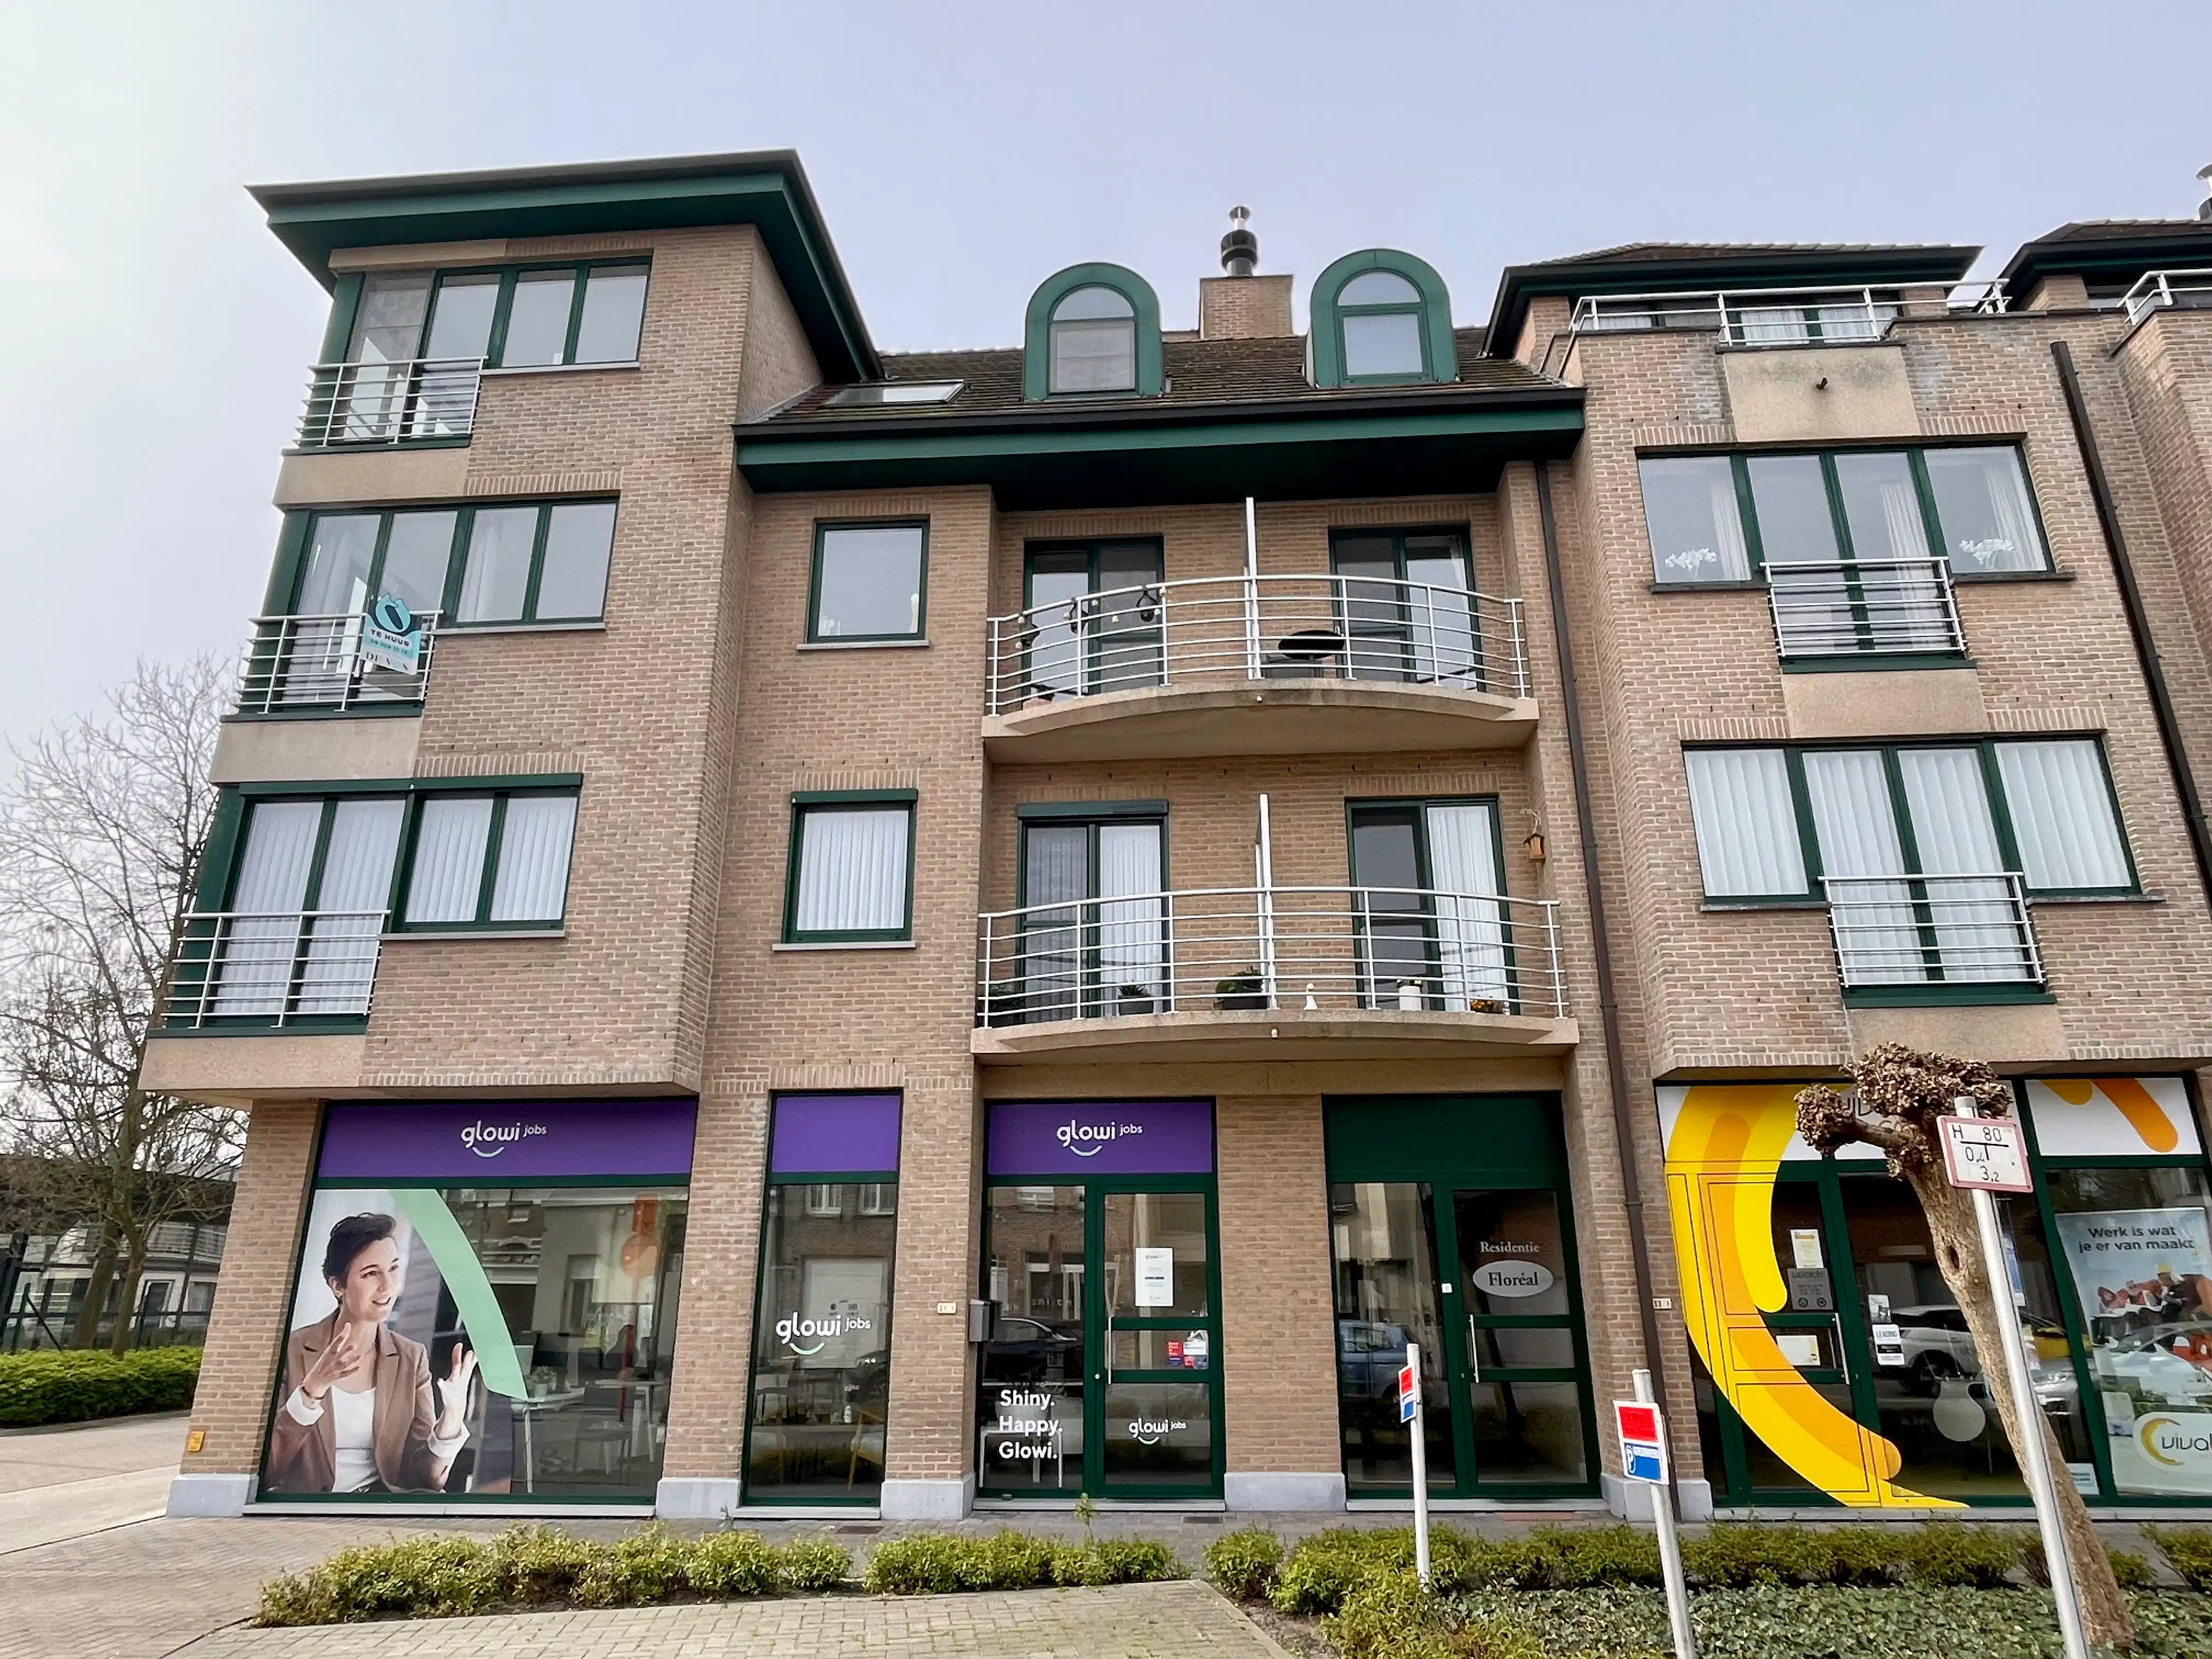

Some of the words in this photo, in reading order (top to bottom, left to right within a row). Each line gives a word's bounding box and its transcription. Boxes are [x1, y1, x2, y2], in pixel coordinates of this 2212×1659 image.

[371, 629, 382, 638] TE
[385, 634, 409, 646] HUUR
[461, 1120, 521, 1148] glowi
[523, 1125, 547, 1137] jobs
[1057, 1119, 1116, 1147] glowi
[1119, 1124, 1143, 1137] jobs
[1951, 1124, 1963, 1139] H
[1983, 1127, 2001, 1142] 80
[1979, 1165, 2000, 1182] 3,2
[2087, 1227, 2129, 1238] Werk
[2131, 1226, 2144, 1237] is
[2148, 1226, 2177, 1236] wat
[1481, 1241, 1541, 1253] Residentie
[2079, 1241, 2091, 1254] je
[2096, 1243, 2110, 1251] er
[2114, 1242, 2142, 1250] van
[1487, 1271, 1539, 1286] Floréal
[776, 1312, 842, 1344] glowi
[845, 1317, 871, 1333] jobs
[1000, 1389, 1055, 1410] Shiny.
[999, 1415, 1063, 1437] Happy.
[1129, 1418, 1168, 1438] glowi
[1171, 1421, 1187, 1431] jobs
[998, 1441, 1058, 1459] Glowi.
